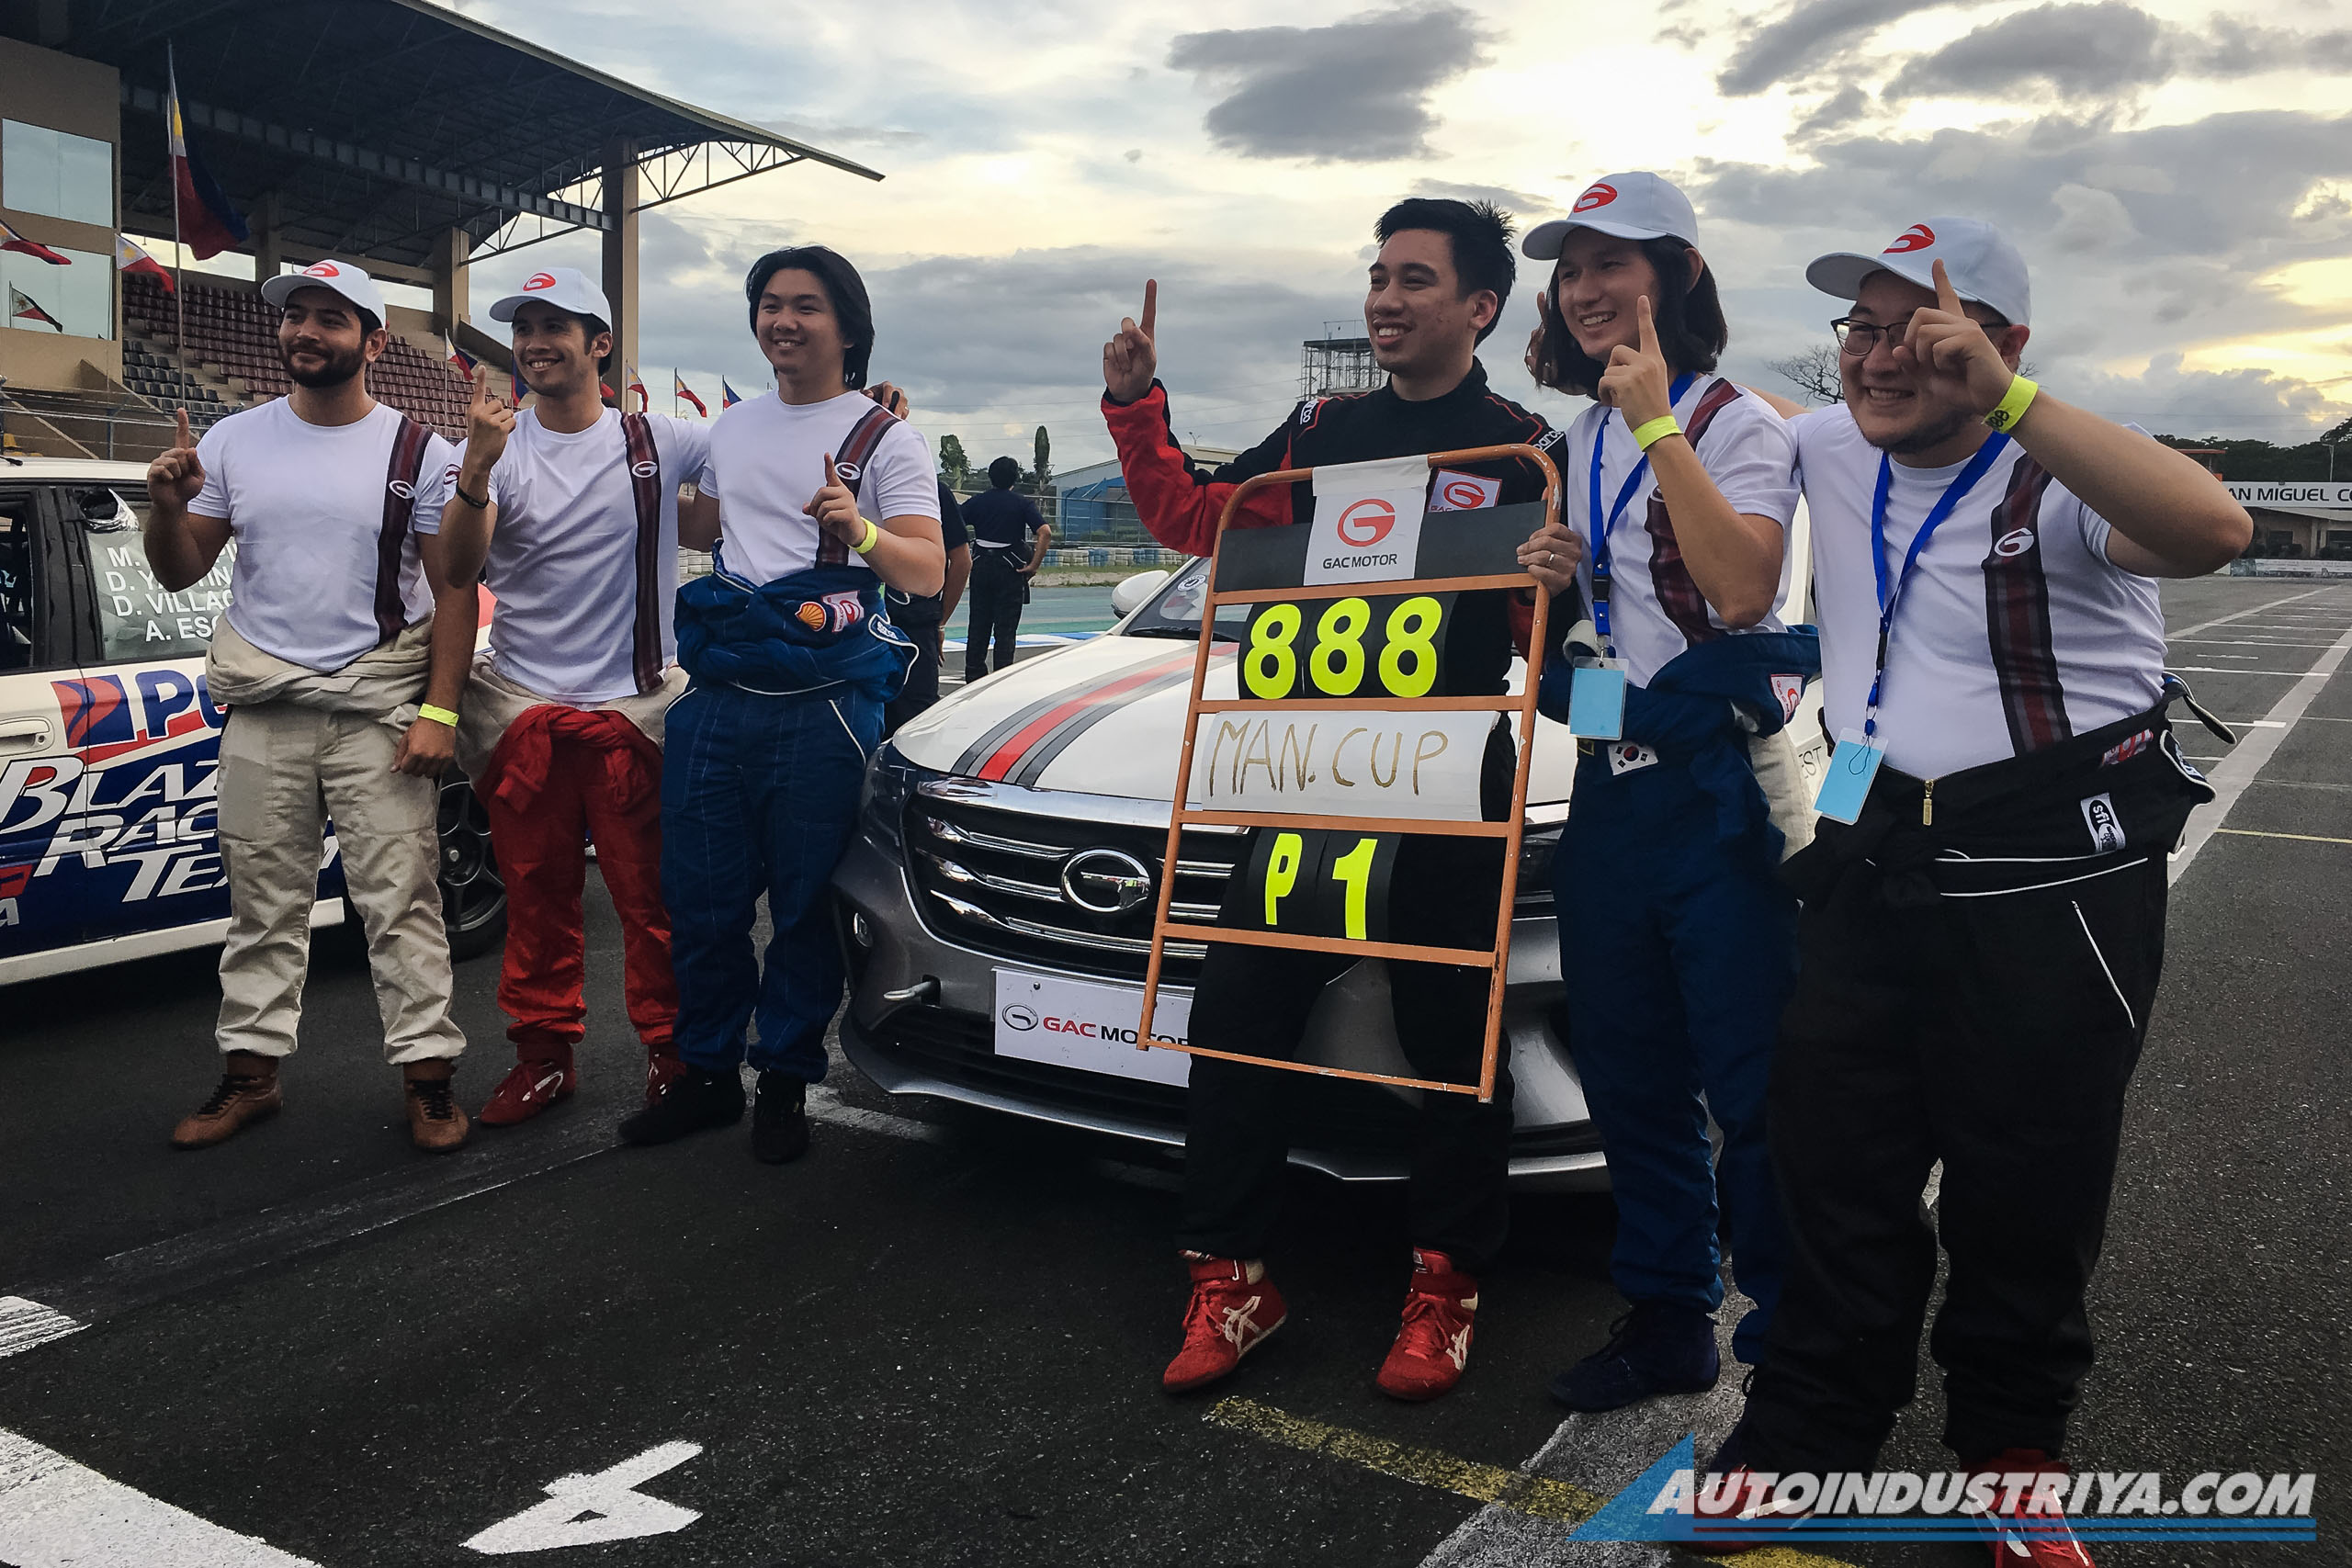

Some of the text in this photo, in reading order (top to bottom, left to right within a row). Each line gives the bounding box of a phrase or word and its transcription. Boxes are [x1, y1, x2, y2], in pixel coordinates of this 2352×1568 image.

[2228, 488, 2352, 502] AN MIGUEL C
[107, 547, 141, 567] M.
[1323, 554, 1397, 569] GAC MOTOR
[106, 570, 135, 592] D.
[112, 595, 141, 616] D.
[145, 619, 172, 641] A.
[1244, 596, 1442, 700] 888
[1043, 1017, 1096, 1038] GAC
